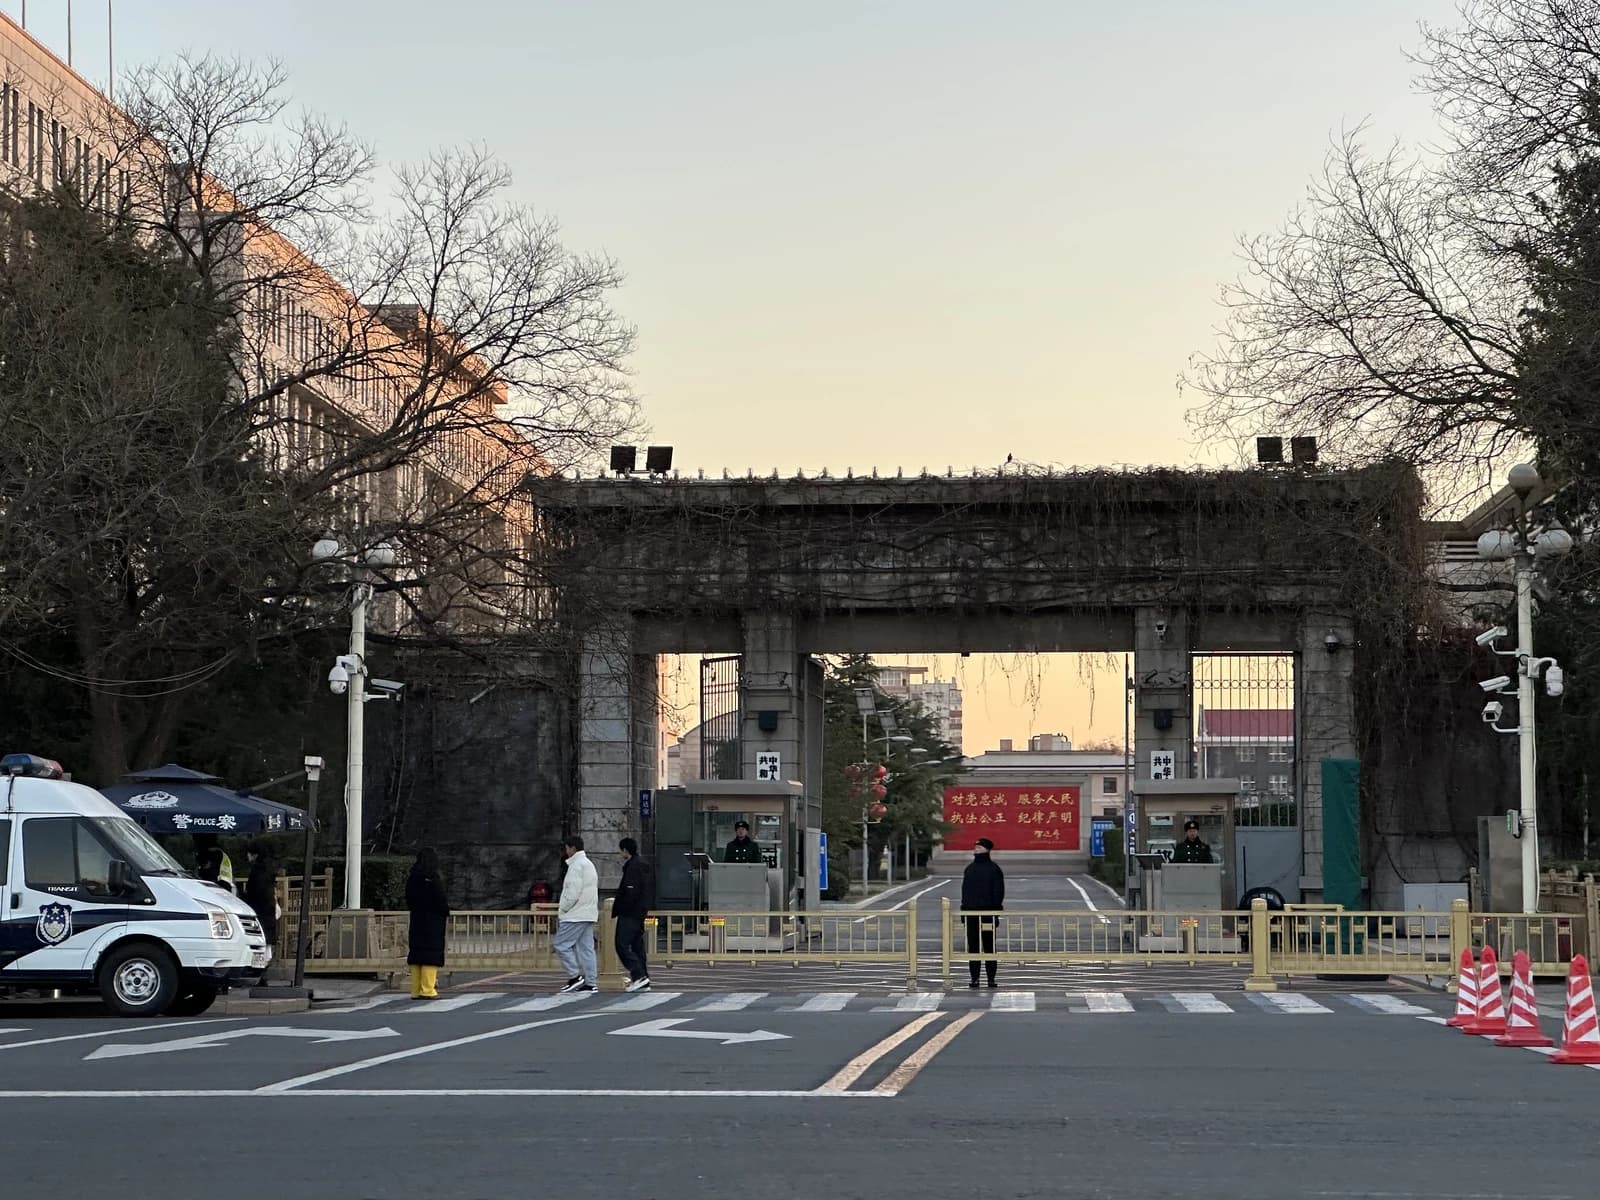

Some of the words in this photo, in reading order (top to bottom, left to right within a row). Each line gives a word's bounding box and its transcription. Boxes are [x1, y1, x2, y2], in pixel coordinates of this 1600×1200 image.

[951, 793, 1008, 806] 对党忠诚
[1017, 793, 1074, 806] 服务人民
[172, 813, 193, 829] 警
[193, 817, 216, 826] POLICE
[216, 814, 237, 830] 察
[950, 811, 1007, 824] 执法公正
[1017, 811, 1073, 824] 纪律严明
